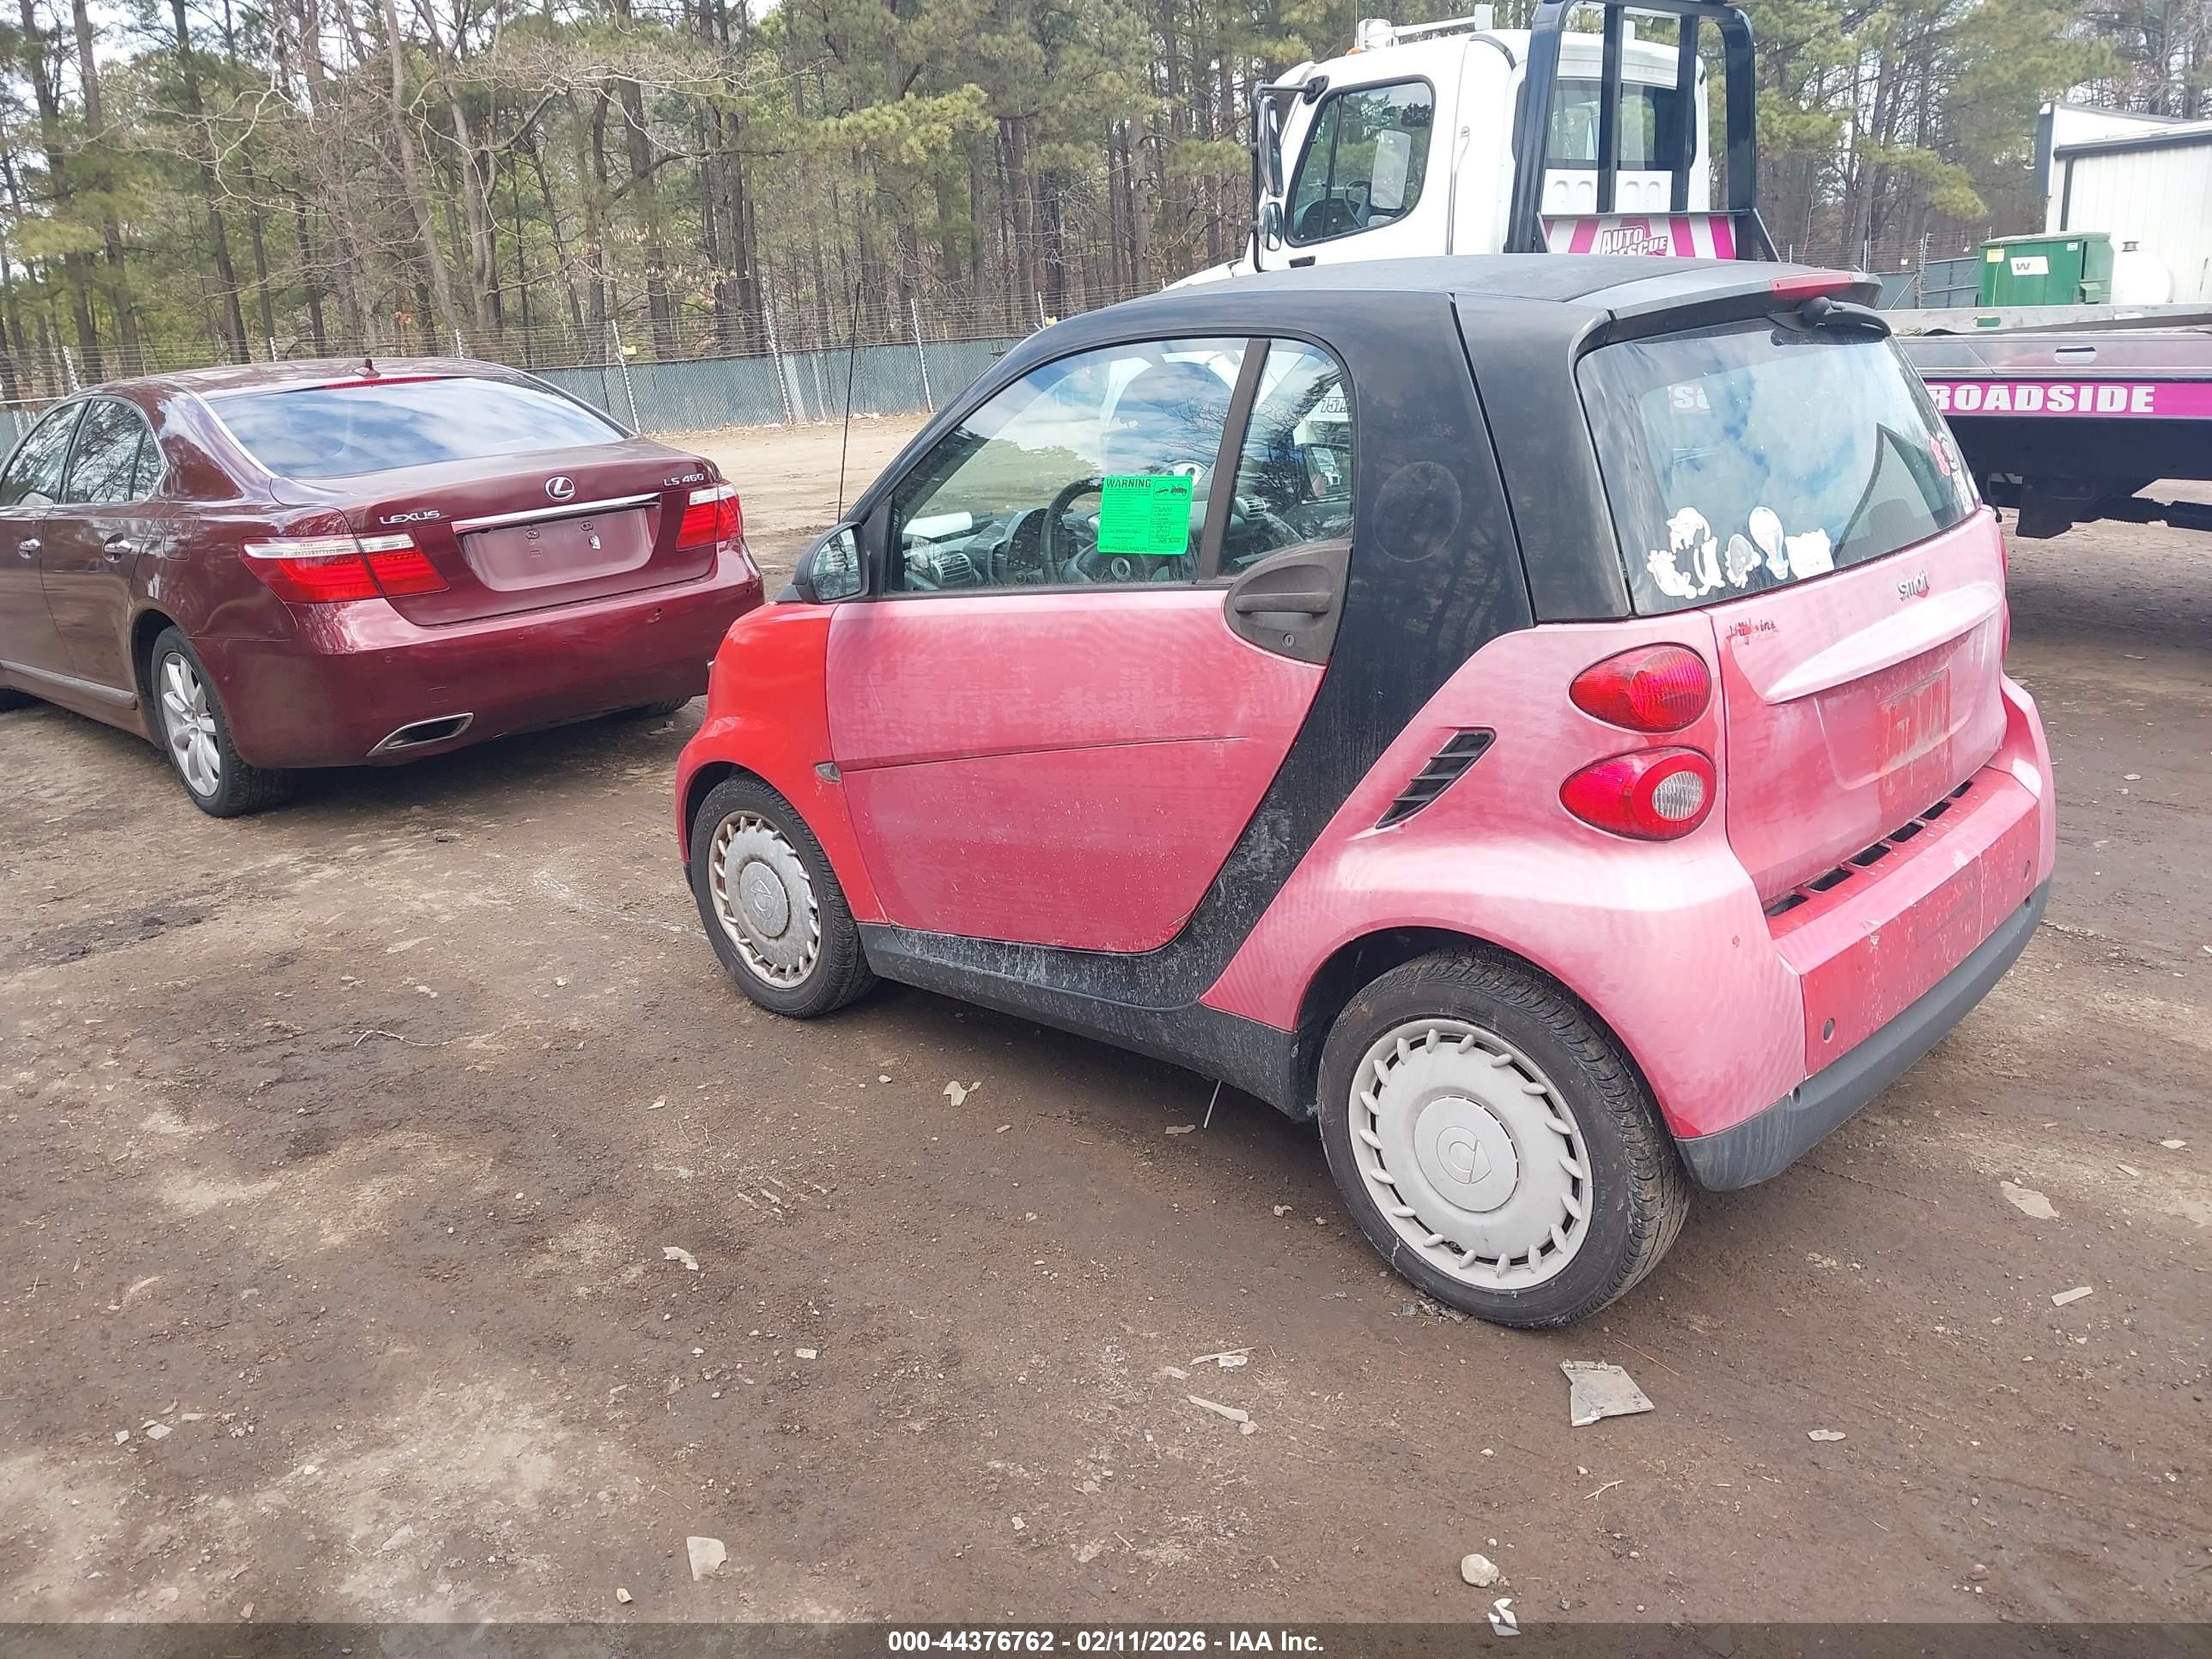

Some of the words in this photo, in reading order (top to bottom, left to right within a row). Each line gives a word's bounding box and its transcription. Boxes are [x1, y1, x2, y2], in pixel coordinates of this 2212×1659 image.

[1601, 226, 1644, 254] AUTO
[1926, 384, 2155, 413] ROADSIDE
[663, 477, 680, 486] LS
[682, 473, 705, 483] 460
[1106, 478, 1152, 489] WARNING
[379, 509, 441, 525] LEXUS
